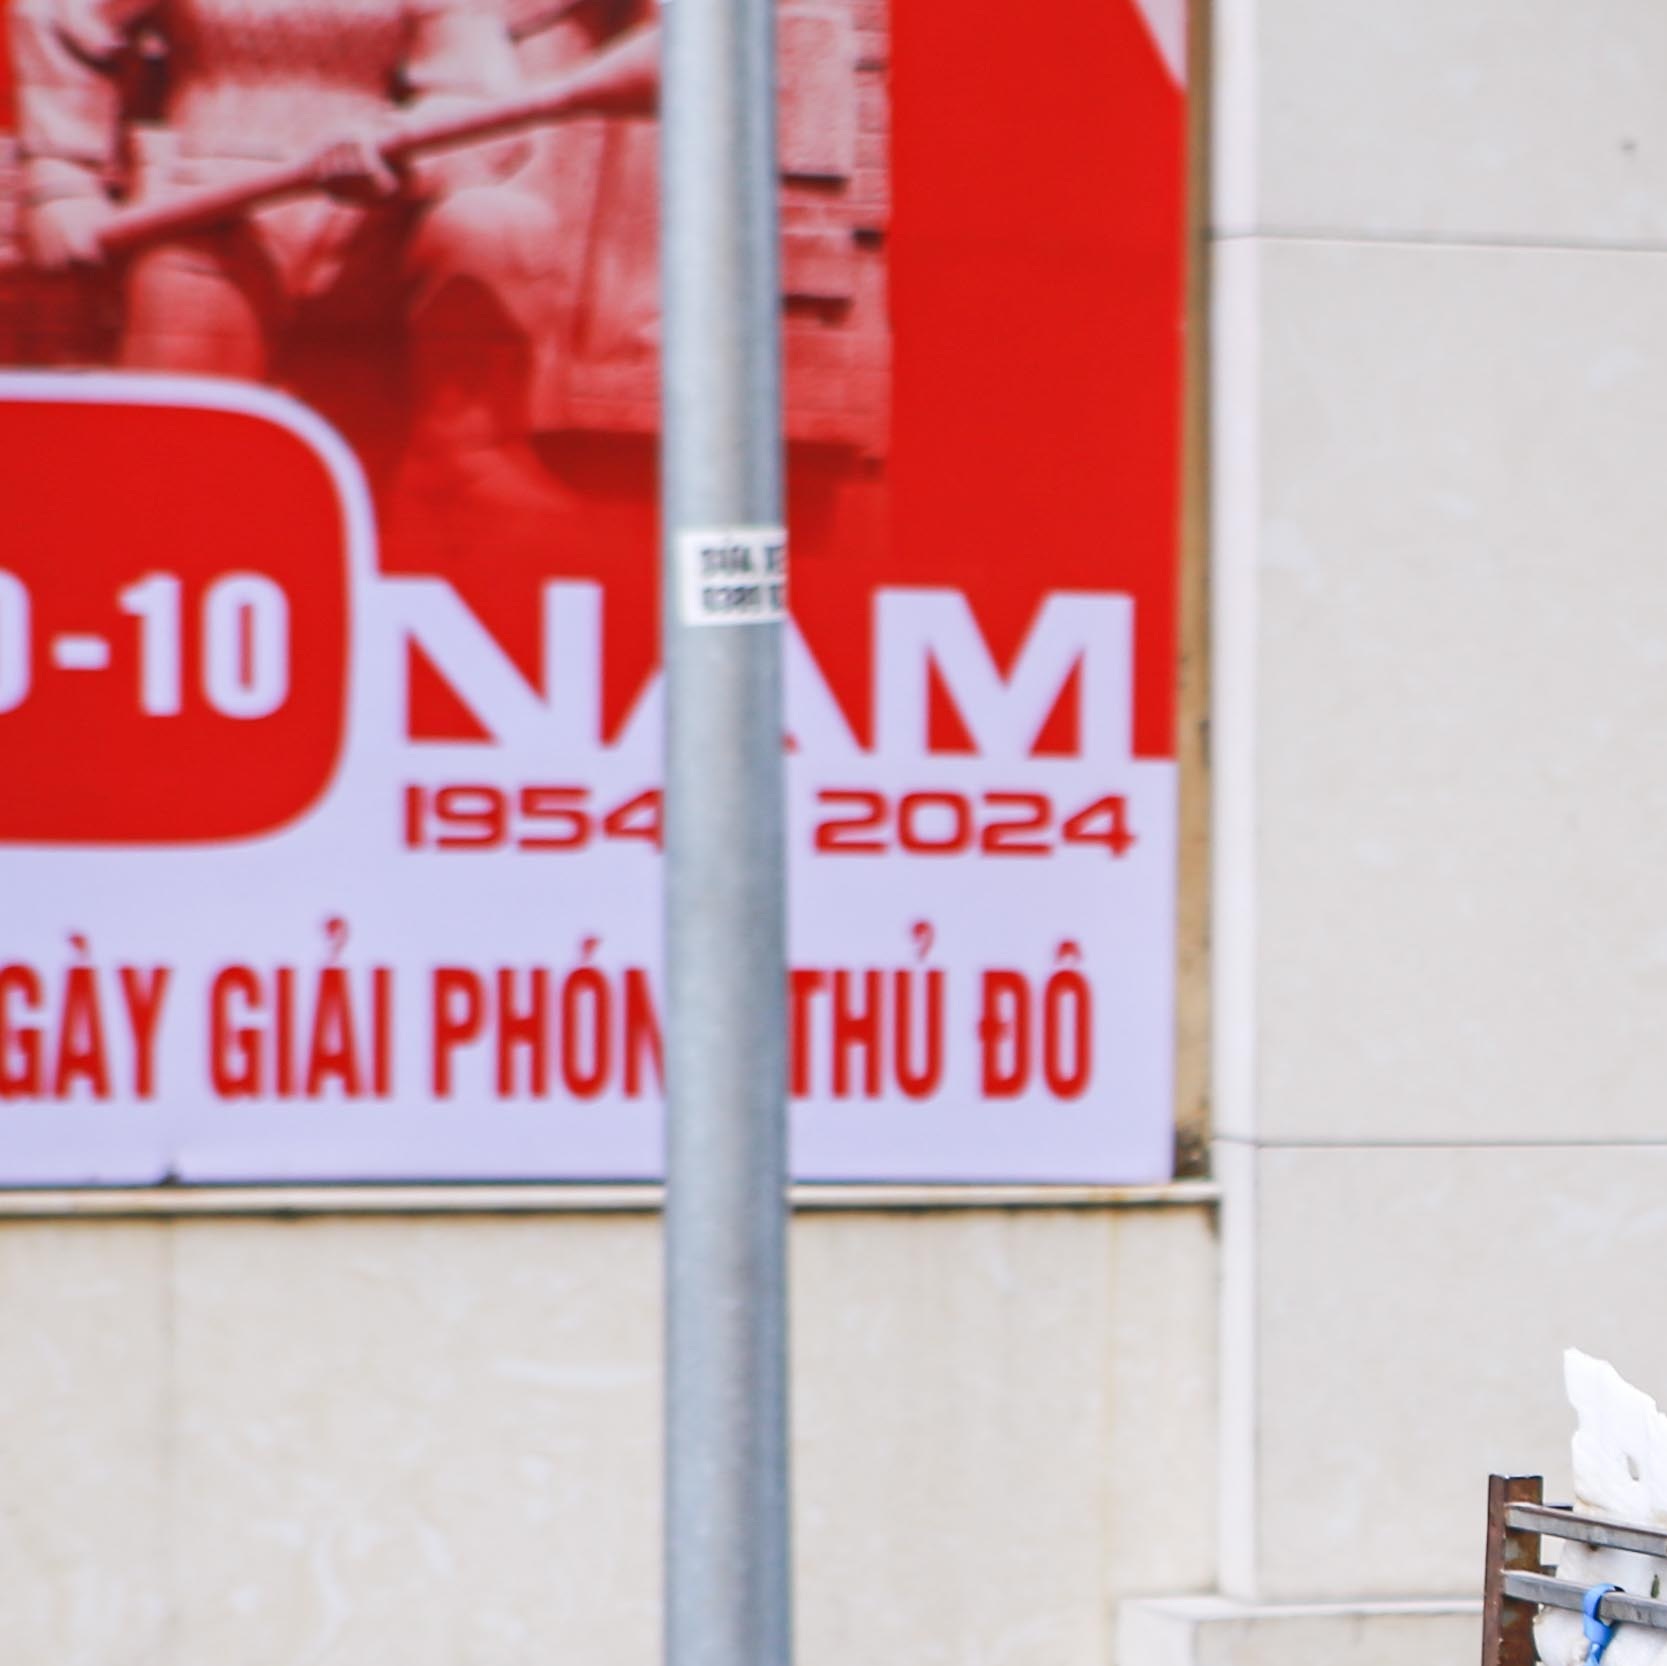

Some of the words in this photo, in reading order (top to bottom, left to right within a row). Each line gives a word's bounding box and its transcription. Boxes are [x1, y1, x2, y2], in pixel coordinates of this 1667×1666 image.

[404, 784, 664, 853] 1954
[813, 788, 1137, 860] 2024
[210, 917, 393, 1100] GIẢI
[788, 921, 944, 1100] THỦ
[979, 940, 1092, 1100] ĐÔ
